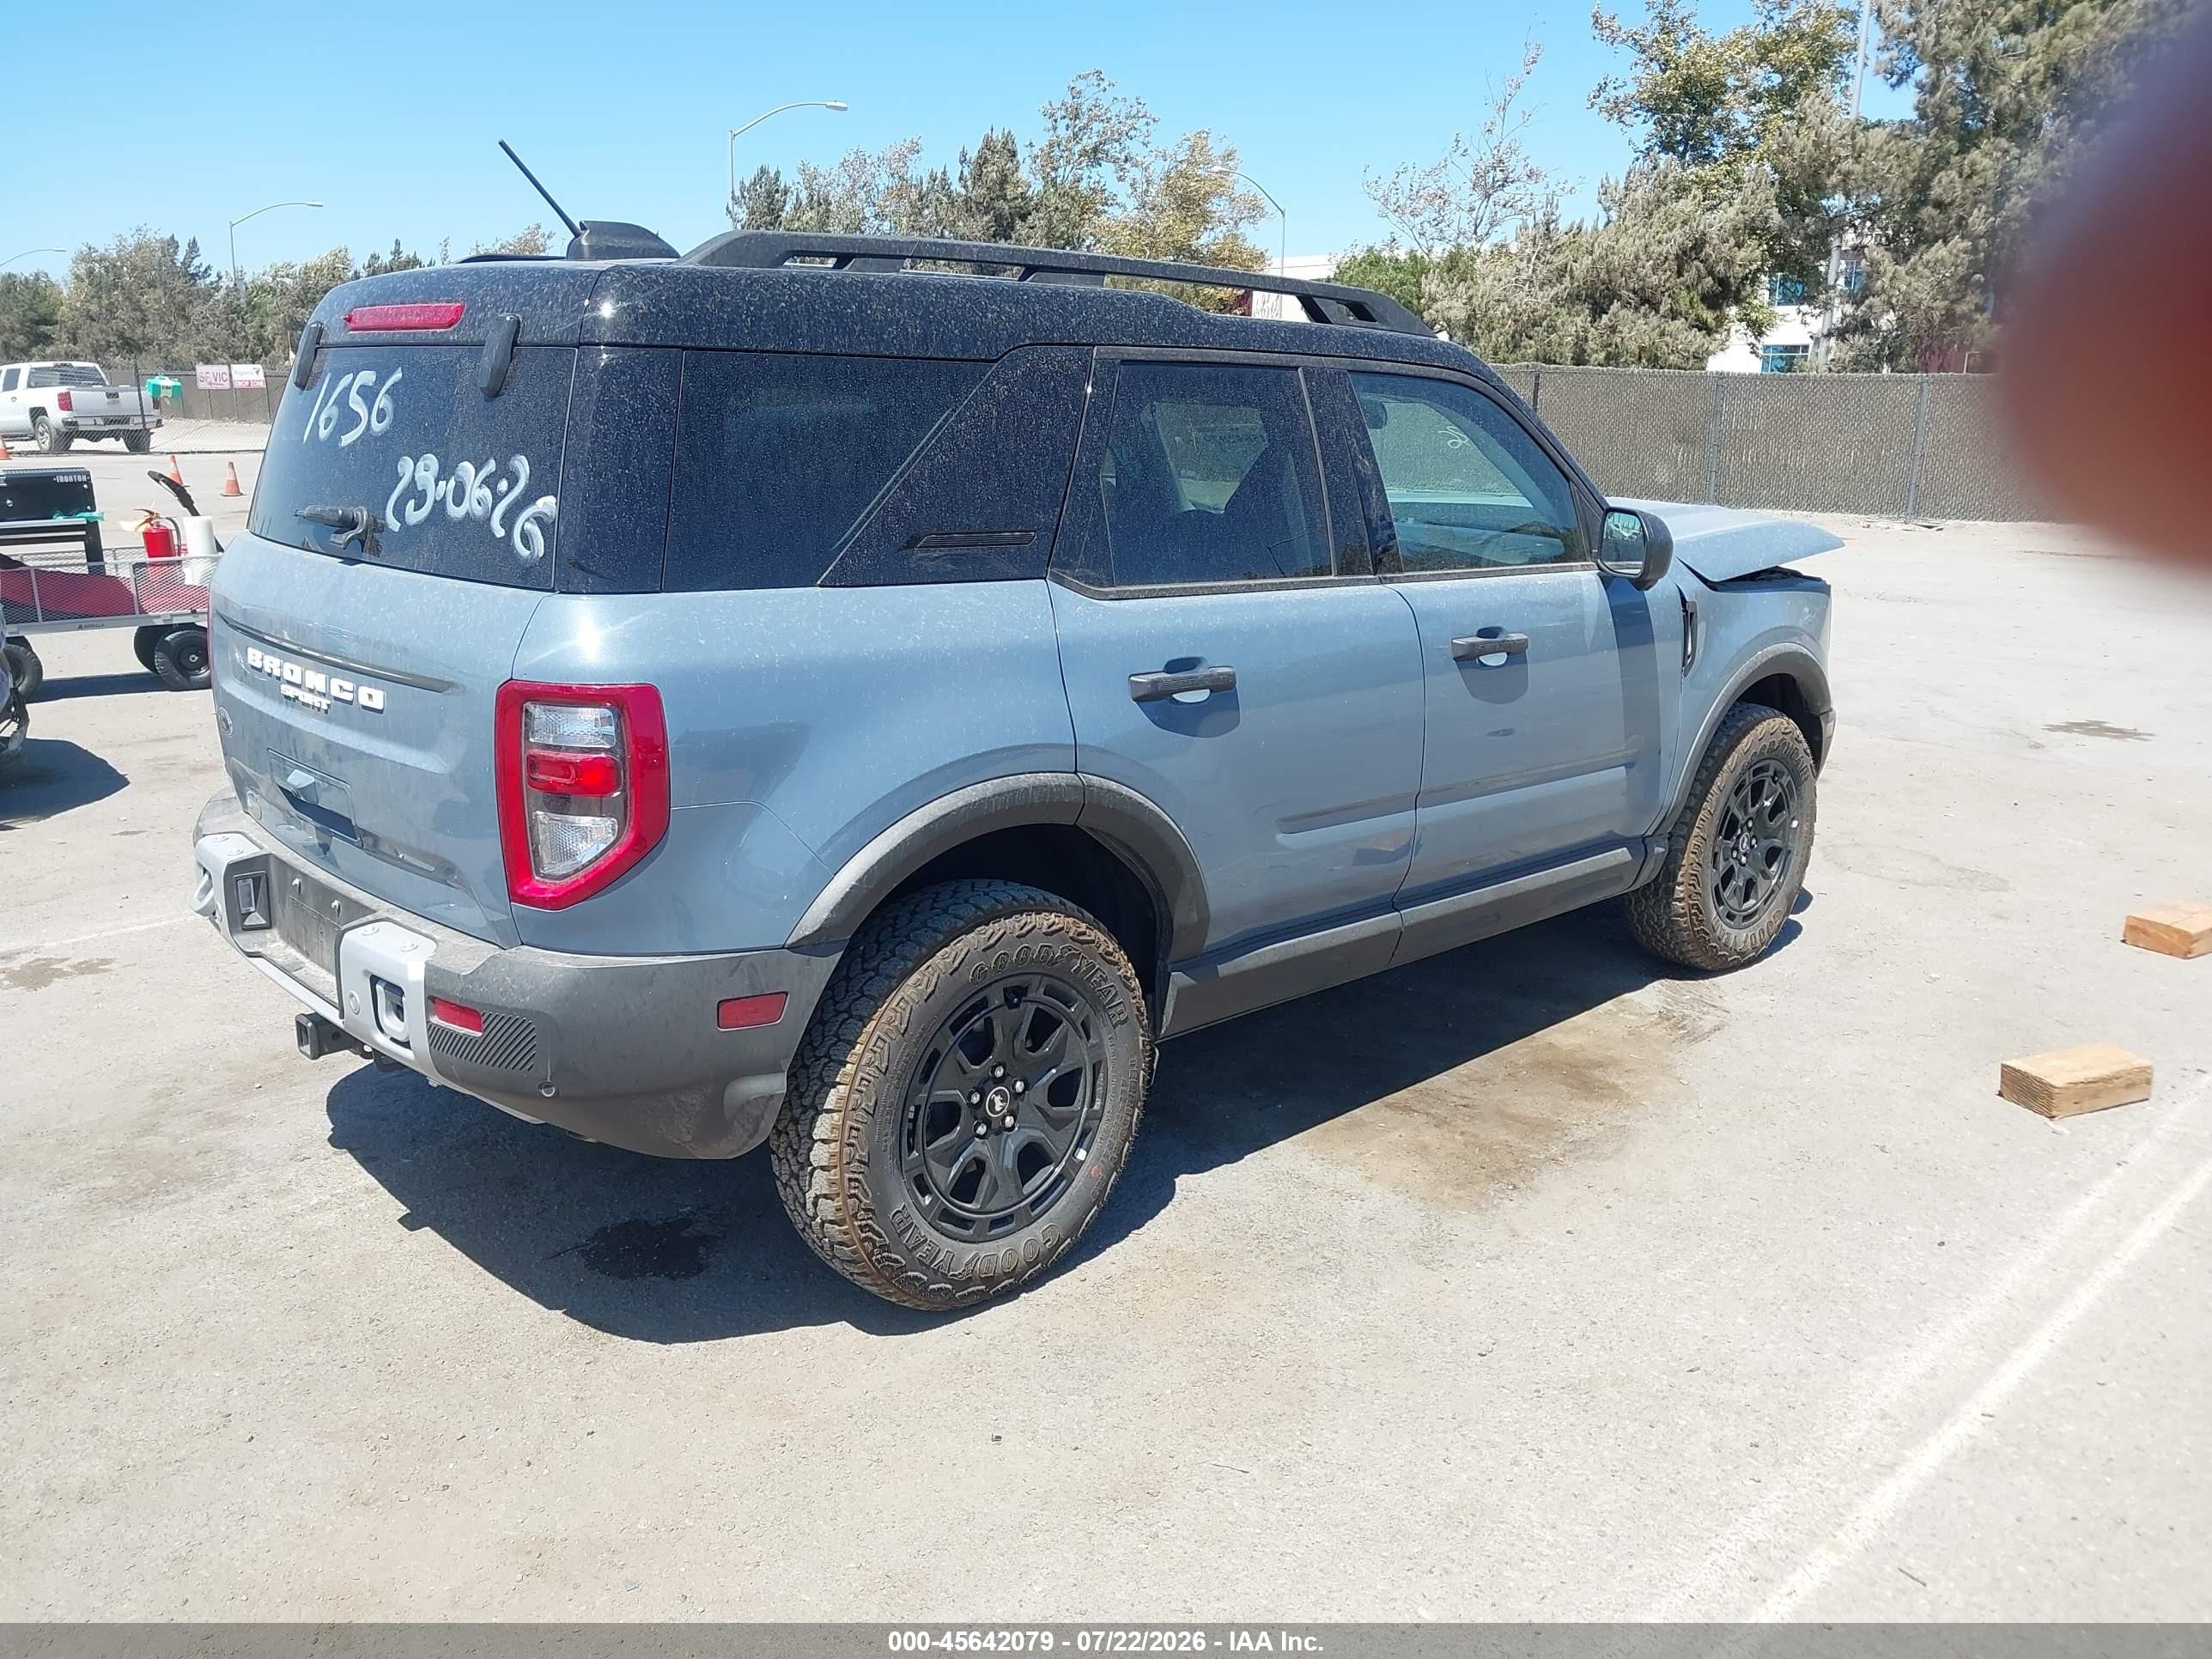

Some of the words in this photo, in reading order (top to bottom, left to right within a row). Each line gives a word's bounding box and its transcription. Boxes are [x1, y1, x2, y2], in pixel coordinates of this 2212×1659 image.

[212, 372, 228, 383] VIC
[303, 367, 403, 447] 1656
[246, 647, 385, 710] BRONCO
[280, 684, 331, 711] SPORT
[969, 942, 1128, 1030] GOODYEAR
[888, 1202, 1061, 1281] GOODYEAR
